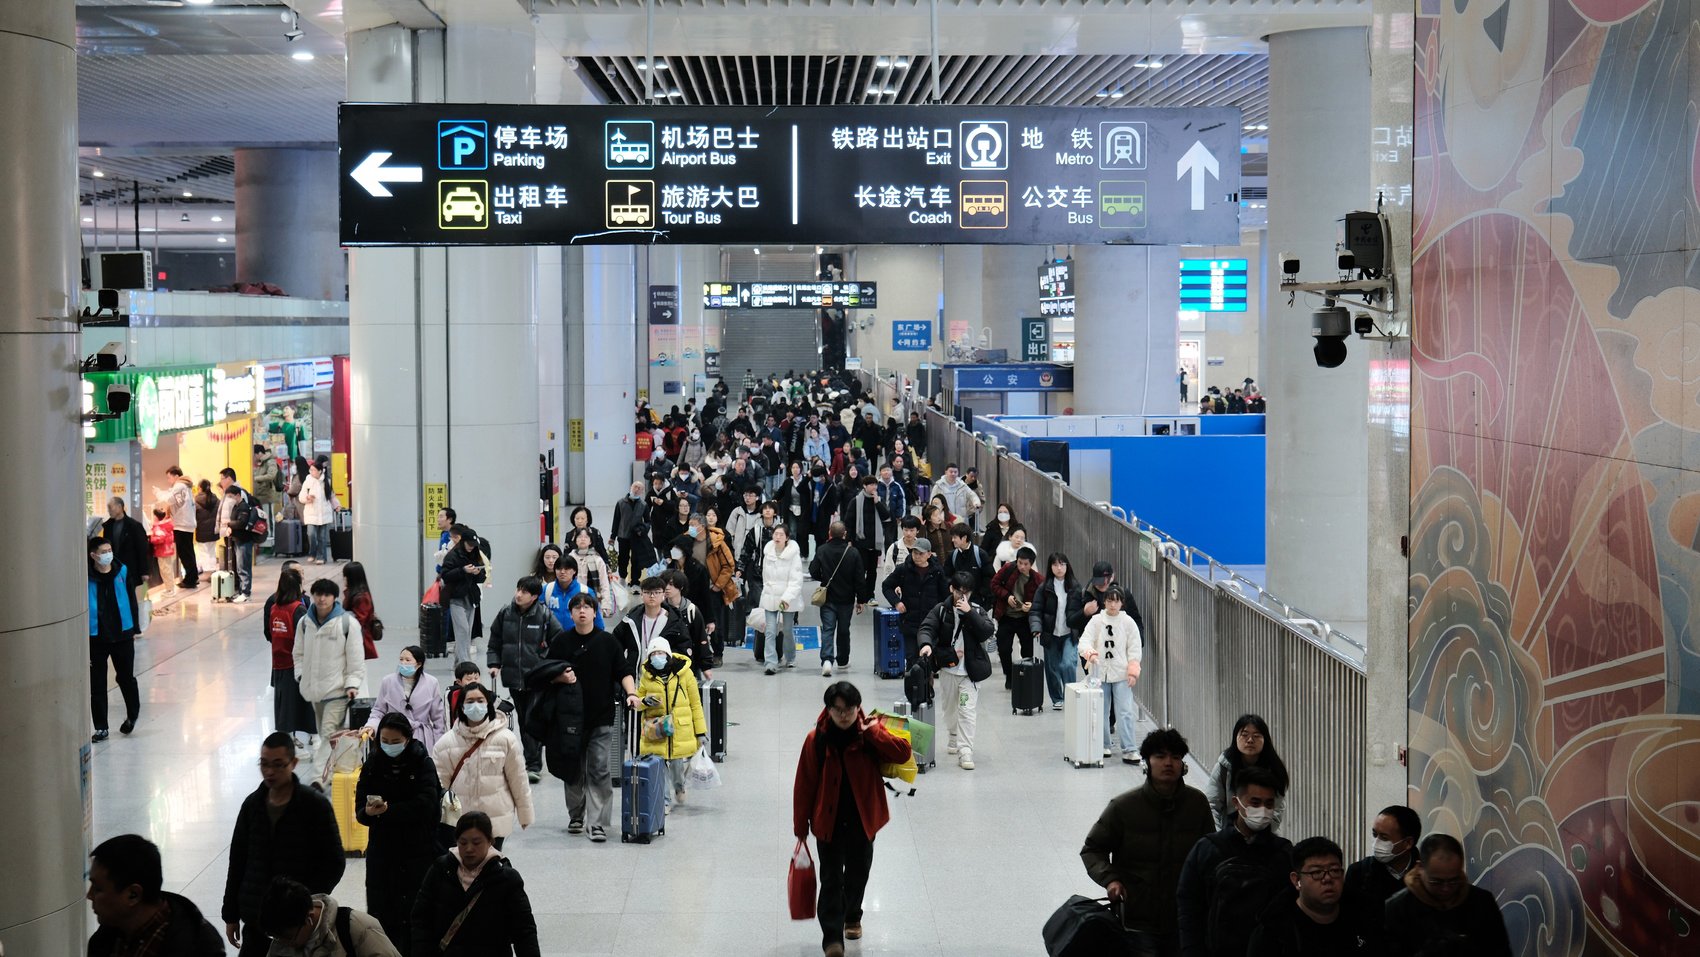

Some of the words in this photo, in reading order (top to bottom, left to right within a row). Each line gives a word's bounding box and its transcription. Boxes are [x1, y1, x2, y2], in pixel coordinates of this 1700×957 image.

[493, 125, 568, 150] 停车场
[661, 125, 760, 150] 机场巴士
[831, 126, 953, 150] 铁路出站口
[493, 152, 545, 169] Parking
[661, 151, 706, 168] Airport
[709, 151, 737, 166] Bus
[926, 151, 952, 165] Exit
[1055, 152, 1094, 165] Metro
[493, 185, 569, 209] 出租车
[661, 185, 760, 209] 旅游大巴
[854, 185, 952, 209] 长途汽车
[1021, 185, 1094, 209] 公交车
[494, 210, 523, 225] Taxi
[661, 210, 692, 225] Tour
[694, 210, 722, 225] Bus
[909, 210, 952, 225] Coach
[1067, 211, 1094, 225] Bus
[1028, 342, 1047, 355] 出口
